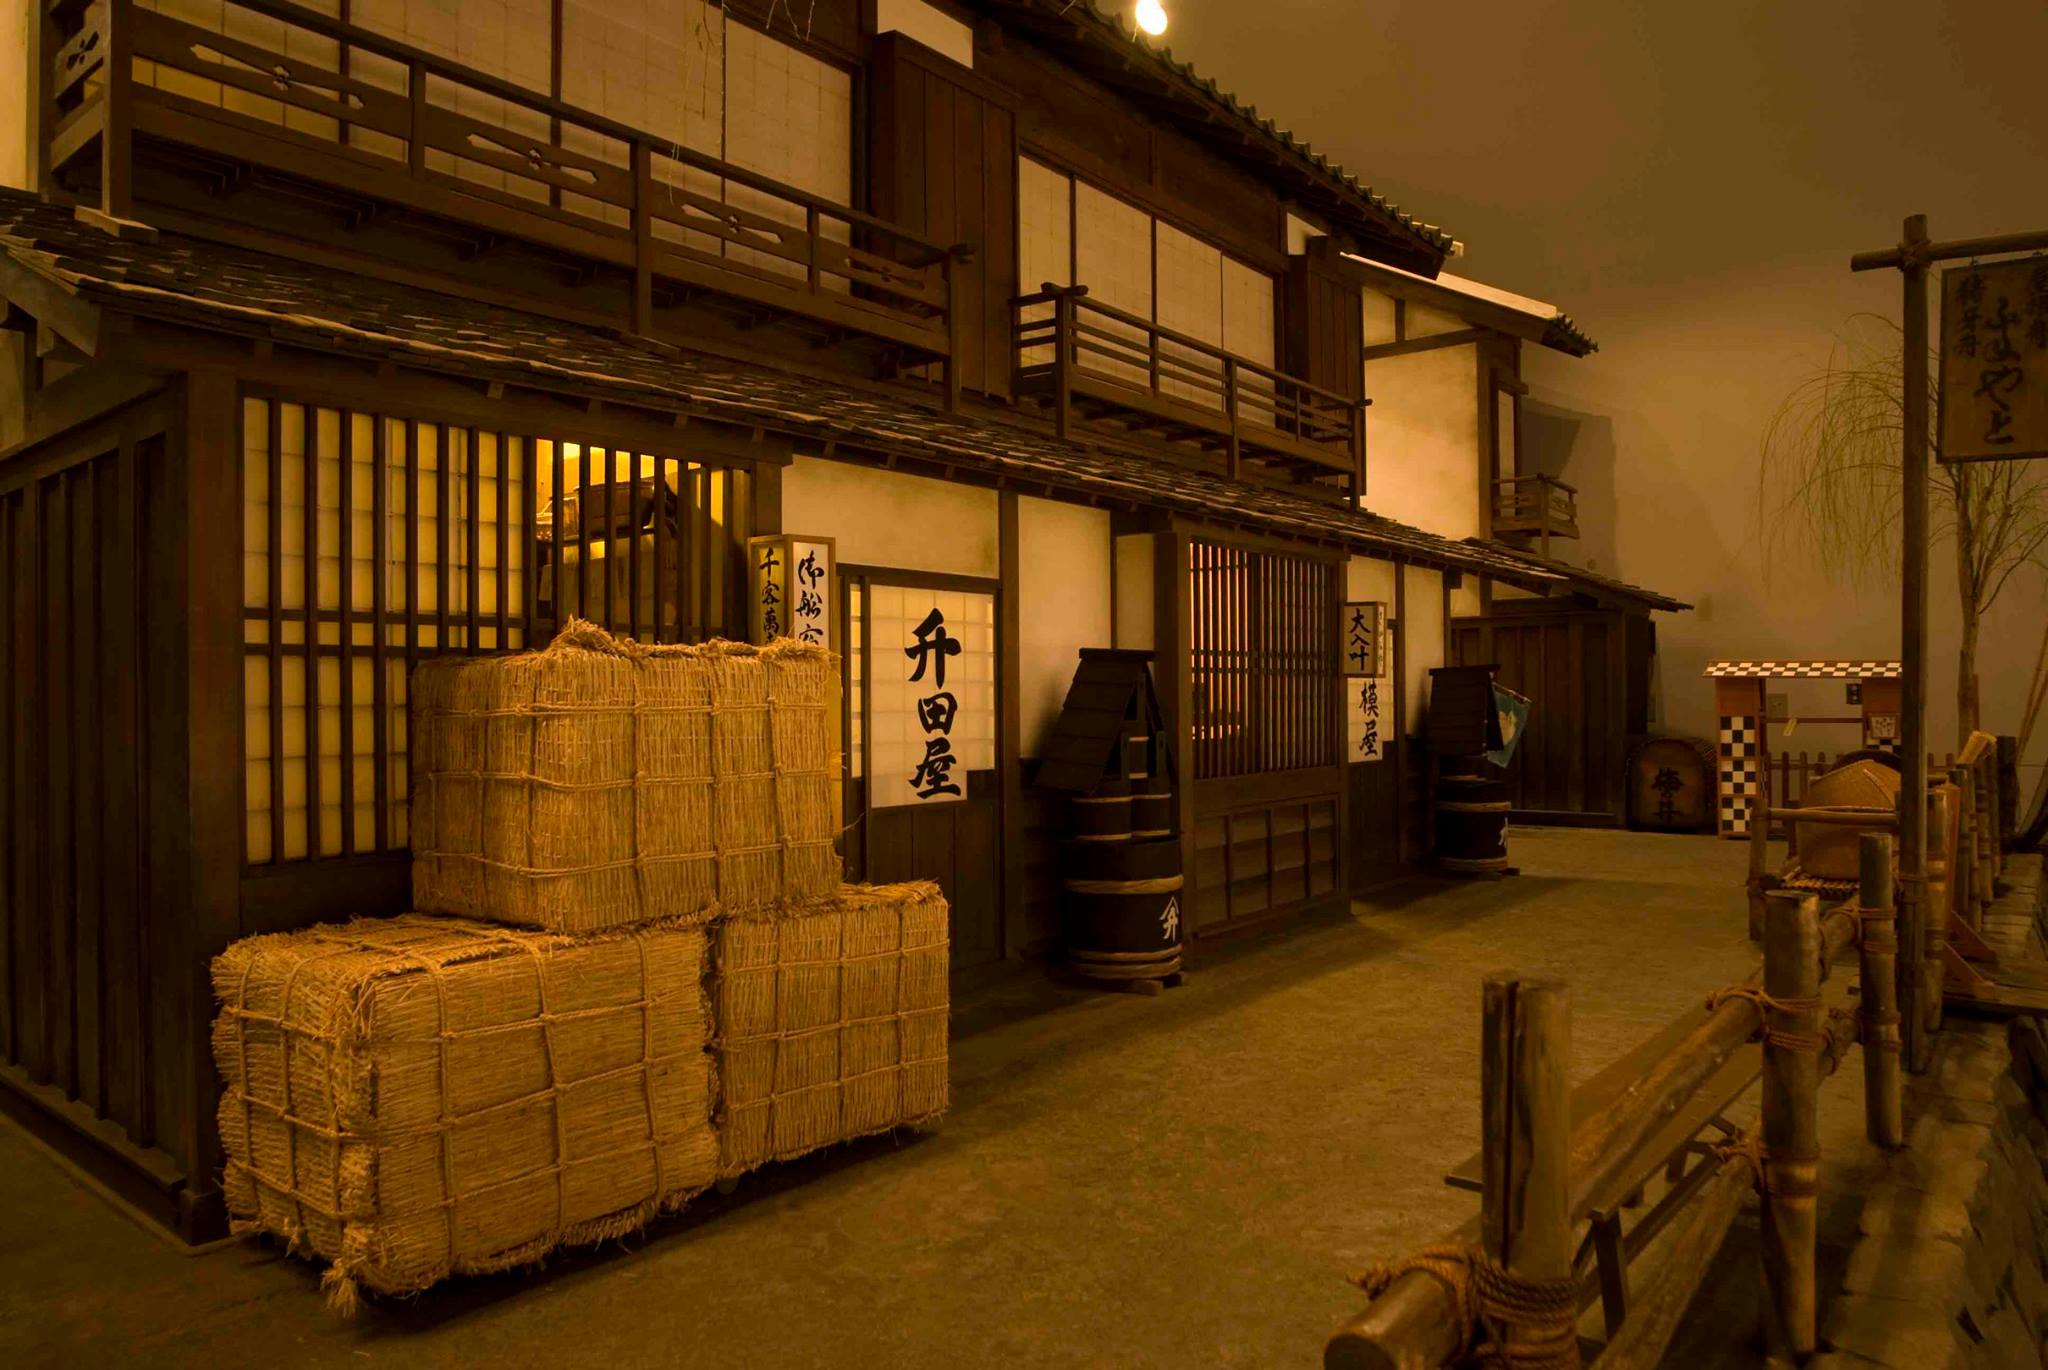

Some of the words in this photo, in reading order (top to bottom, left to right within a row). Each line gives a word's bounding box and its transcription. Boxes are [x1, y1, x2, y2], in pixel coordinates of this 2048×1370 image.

[760, 547, 780, 642] 千客萬
[904, 607, 962, 799] 升田屋
